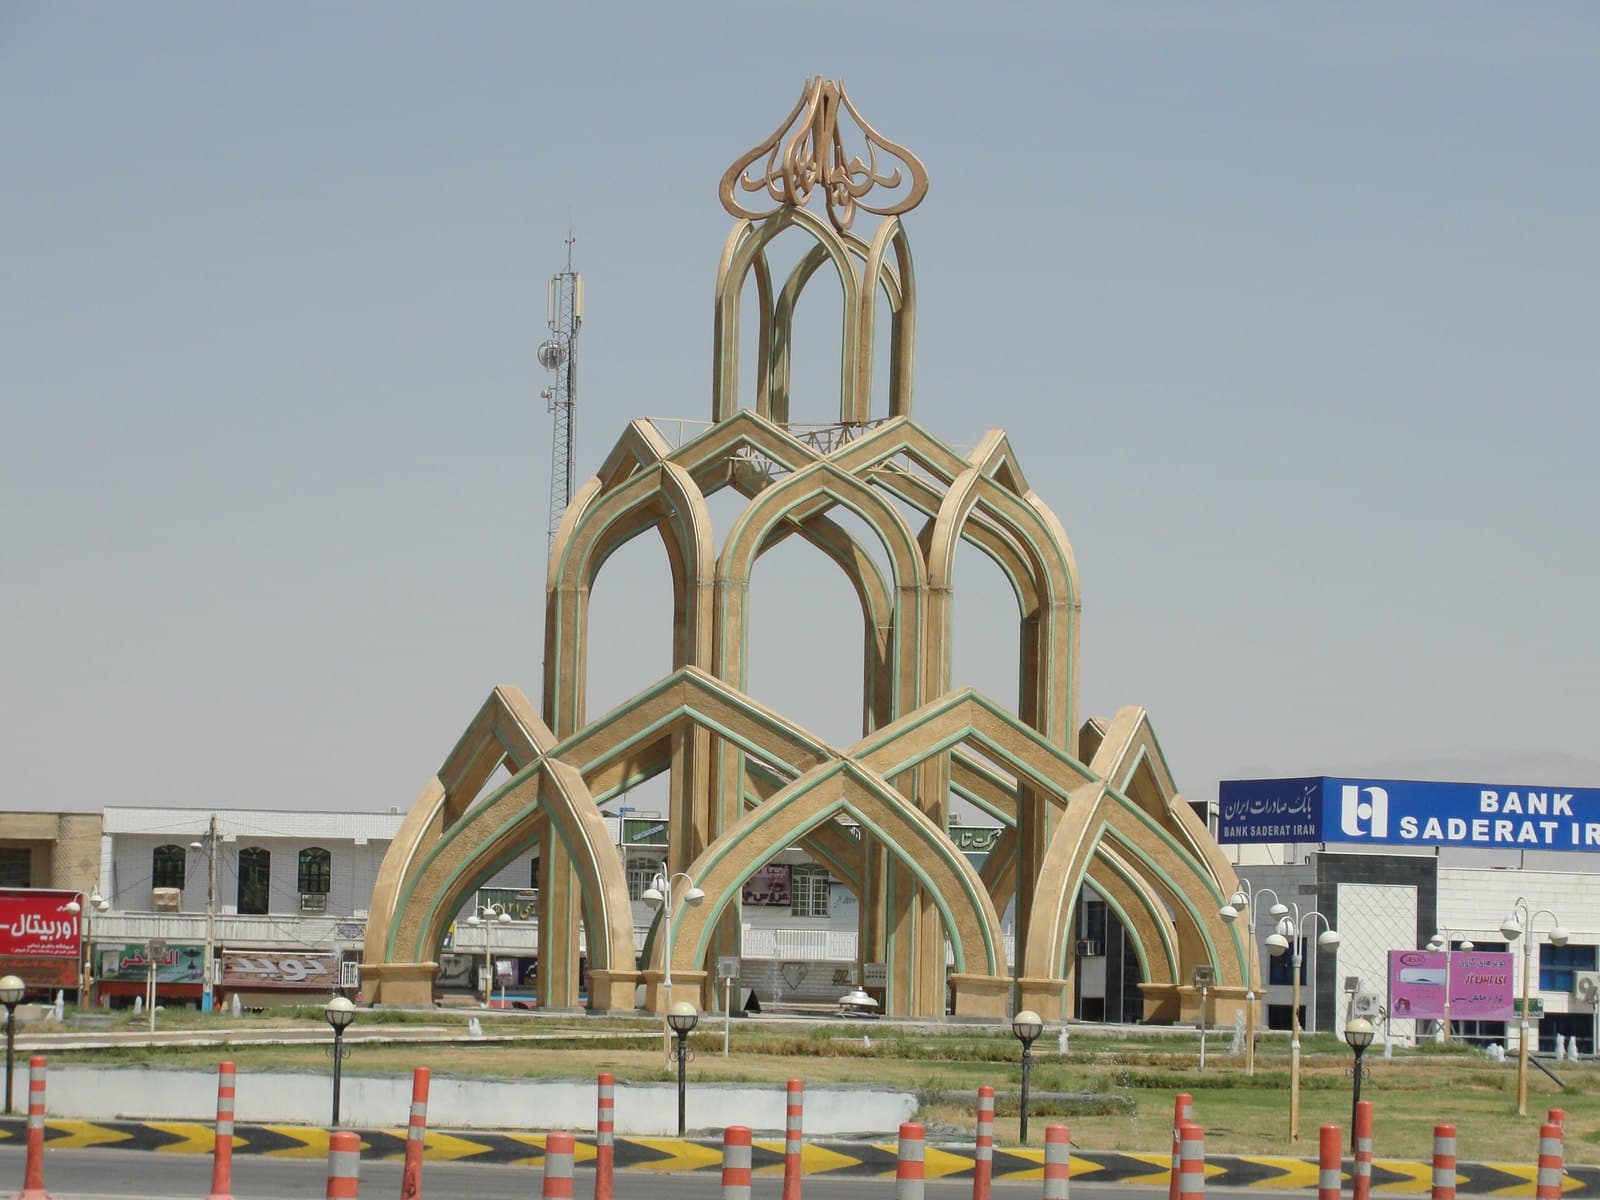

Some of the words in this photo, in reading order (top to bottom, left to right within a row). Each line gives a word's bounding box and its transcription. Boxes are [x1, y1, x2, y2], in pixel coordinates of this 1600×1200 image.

[1224, 799, 1249, 820] ایران
[1250, 796, 1287, 814] صادرات
[1288, 784, 1317, 820] بانک
[1480, 790, 1574, 816] BANK
[1224, 826, 1248, 837] BANK
[1250, 825, 1291, 836] SADERAT
[1293, 824, 1315, 835] IRAN
[1400, 816, 1558, 844] SADERAT
[11, 914, 78, 940] اوربیتال
